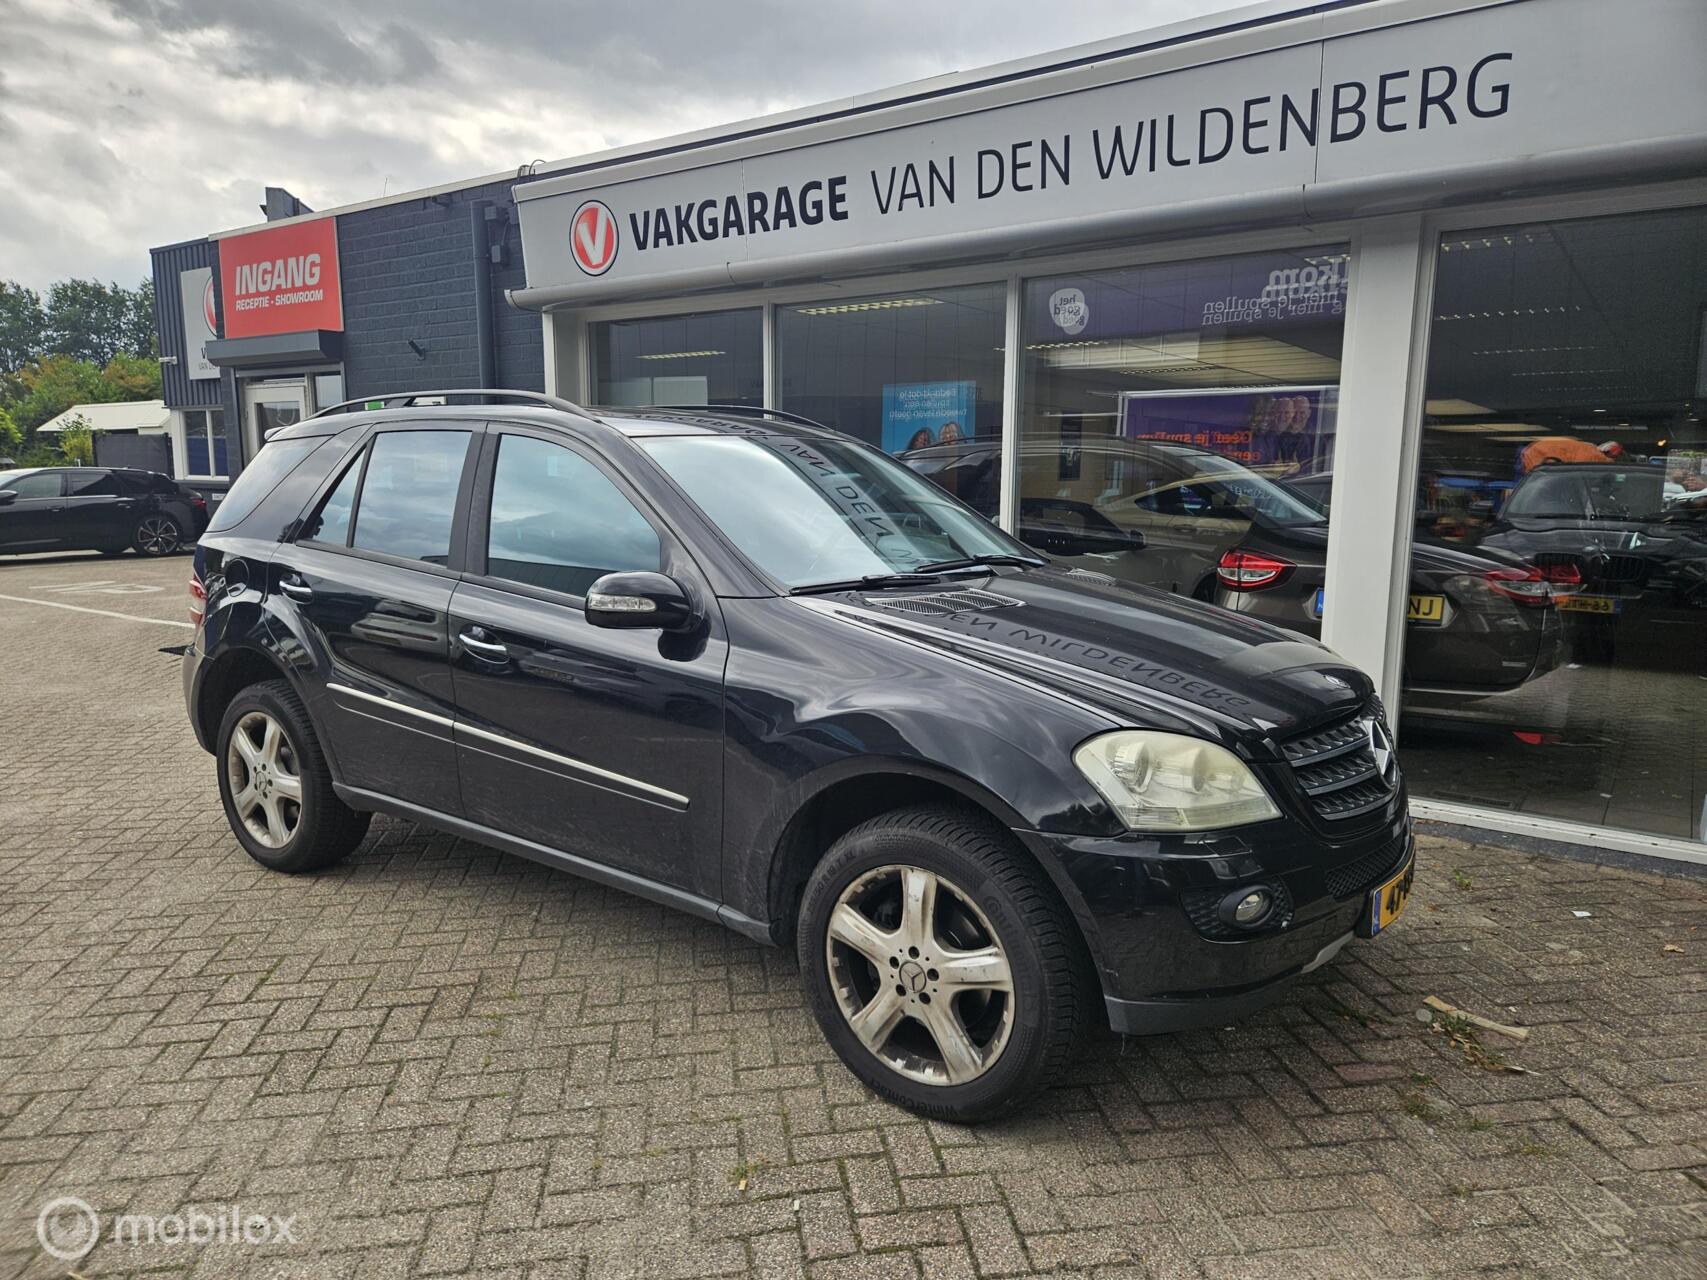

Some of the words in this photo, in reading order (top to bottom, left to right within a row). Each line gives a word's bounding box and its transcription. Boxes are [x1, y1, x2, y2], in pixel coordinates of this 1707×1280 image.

[629, 176, 849, 251] VAKGARAGE
[871, 155, 956, 215] VAN
[977, 135, 1071, 200] DEN
[1093, 52, 1513, 180] WILDENBERG
[235, 253, 321, 295] INGANG
[235, 297, 269, 311] RECEPTIE
[275, 290, 323, 305] SHOWROOM
